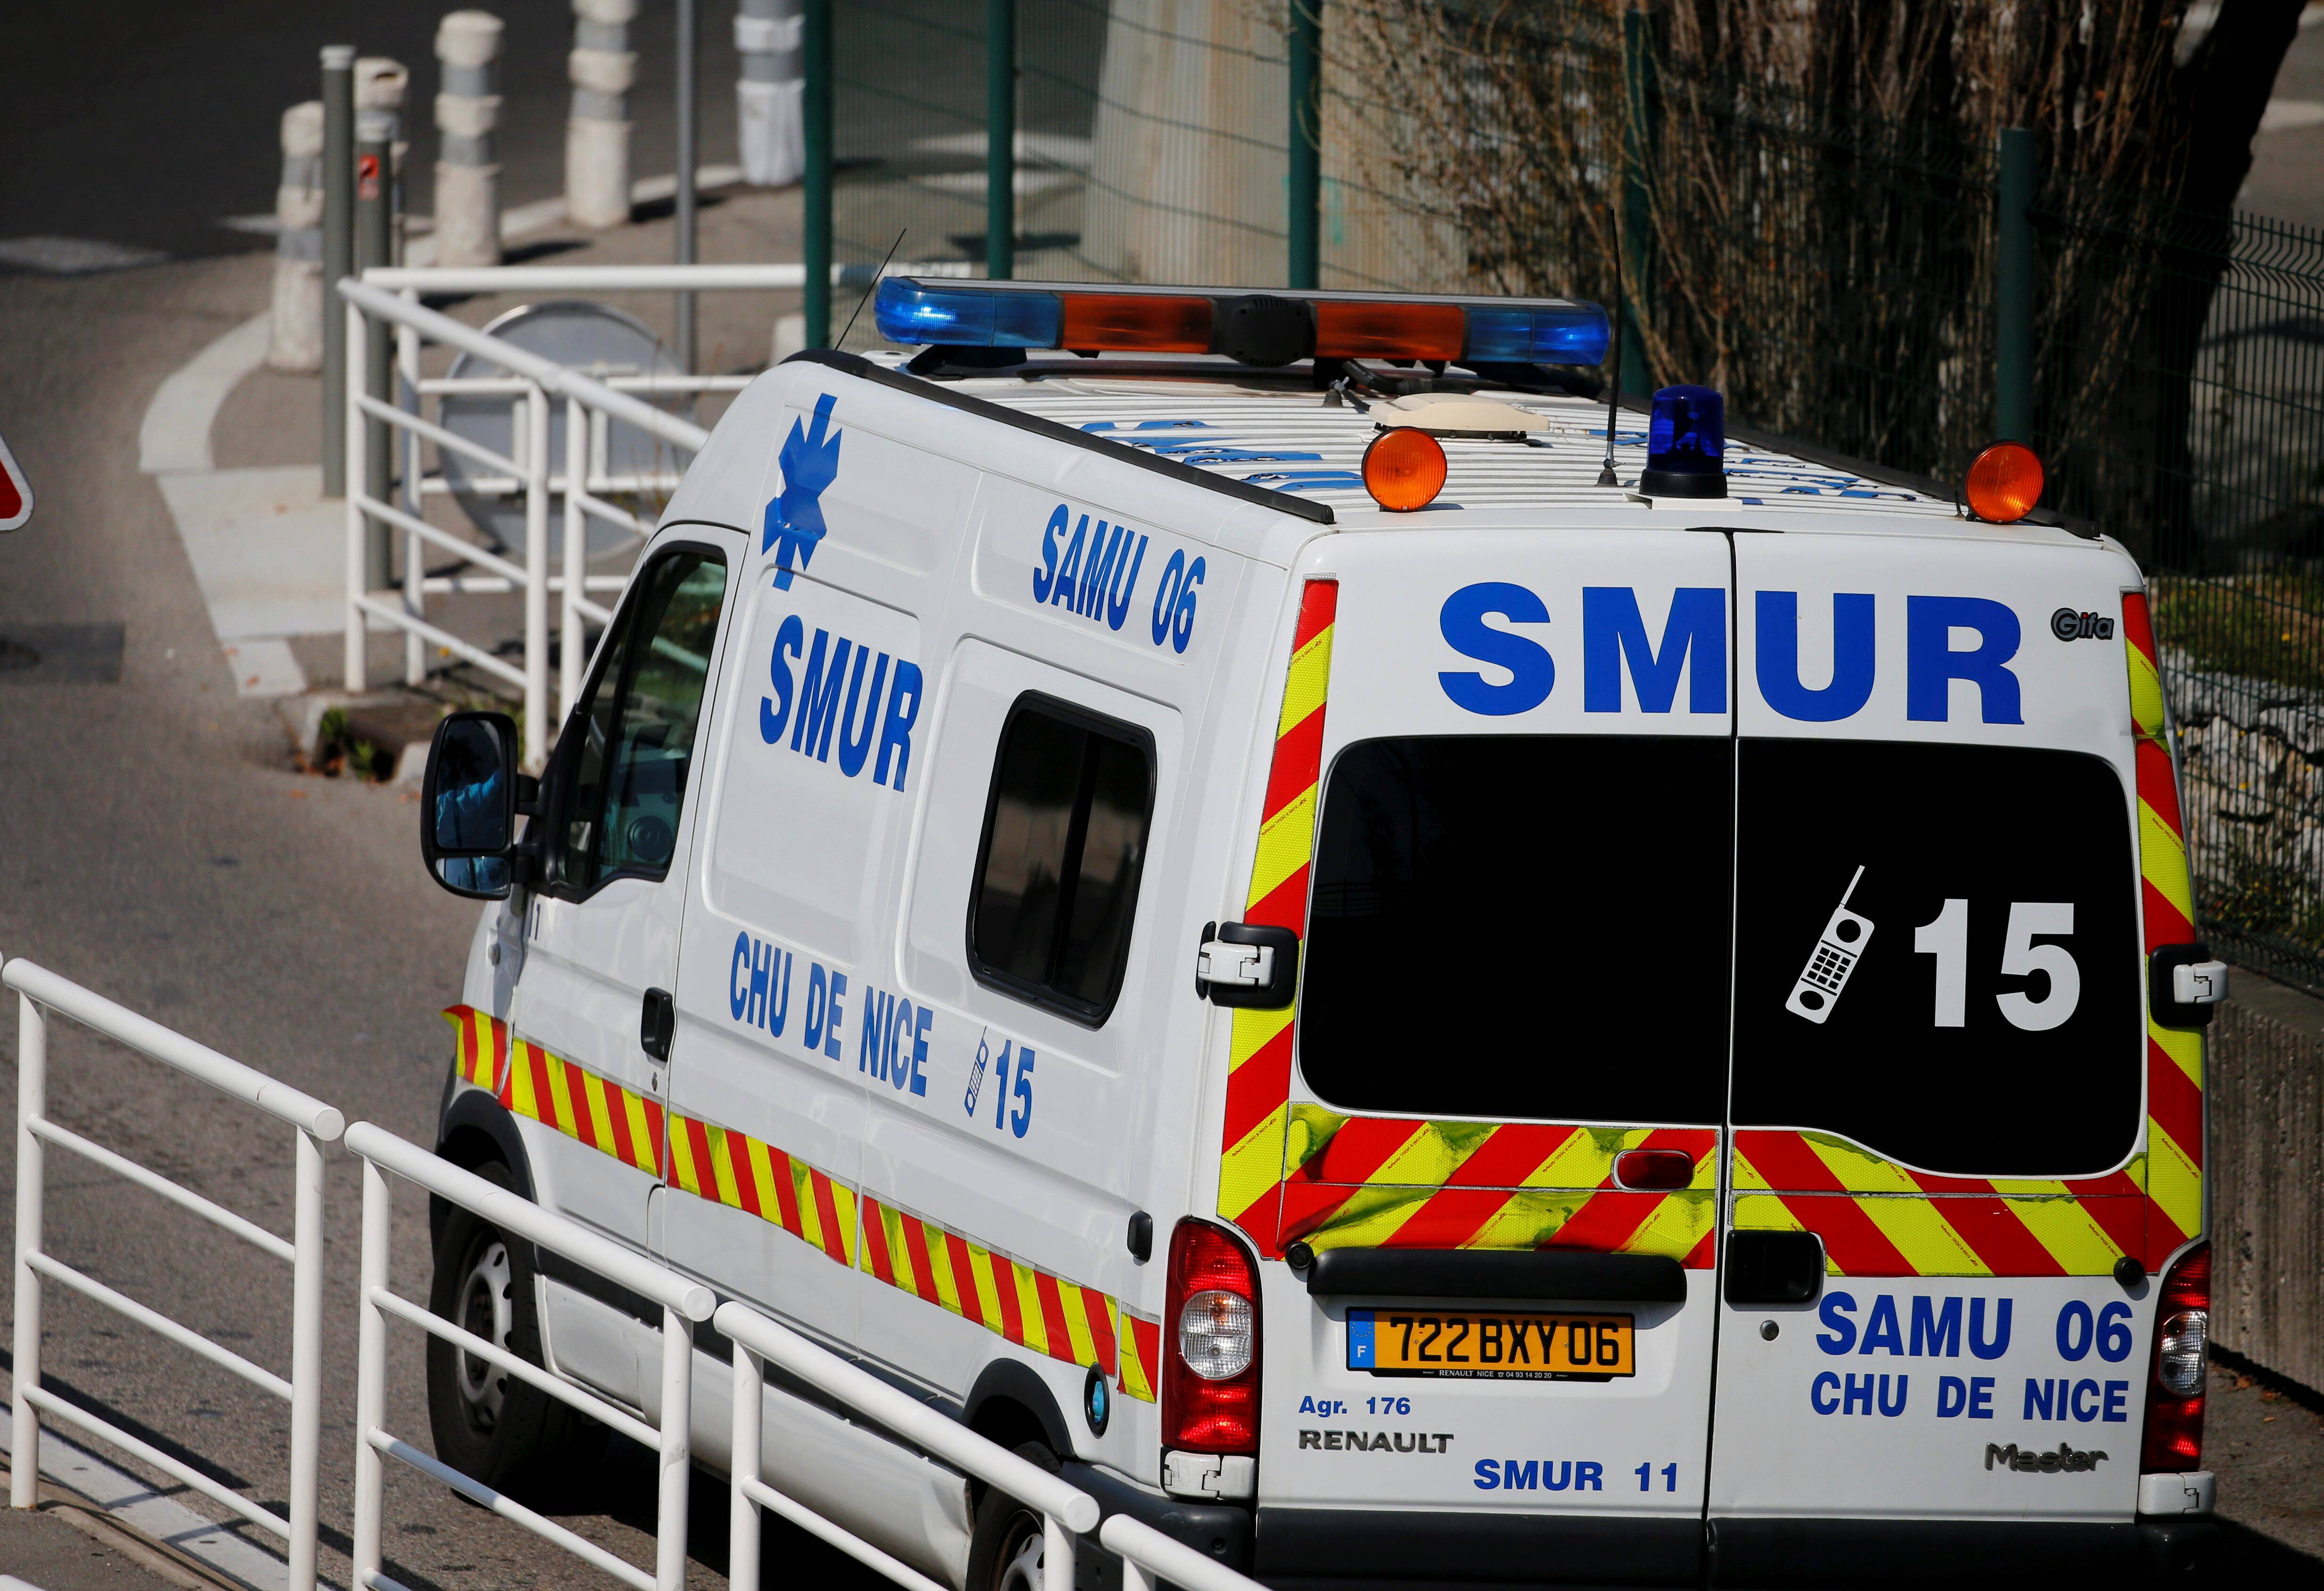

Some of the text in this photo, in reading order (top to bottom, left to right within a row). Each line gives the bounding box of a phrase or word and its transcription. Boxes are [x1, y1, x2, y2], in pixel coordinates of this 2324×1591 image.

[1033, 504, 1206, 654] SAMU 06
[1438, 581, 2025, 725] SMUR
[2050, 607, 2115, 642] Gifa
[759, 614, 923, 792] SMUR
[1914, 898, 2080, 1031] 15
[730, 931, 933, 1097] CHU DE NICE
[996, 1039, 1035, 1138] 15
[1357, 1345, 1366, 1358] F
[1816, 1291, 2132, 1362] SAMU 06
[1299, 1395, 1411, 1418] Agr. 176
[1811, 1371, 2129, 1422] CHU DE NICE
[1299, 1429, 1455, 1454] RENAULT
[1984, 1442, 2109, 1473] Master
[1474, 1459, 1677, 1492] SMUR 11
